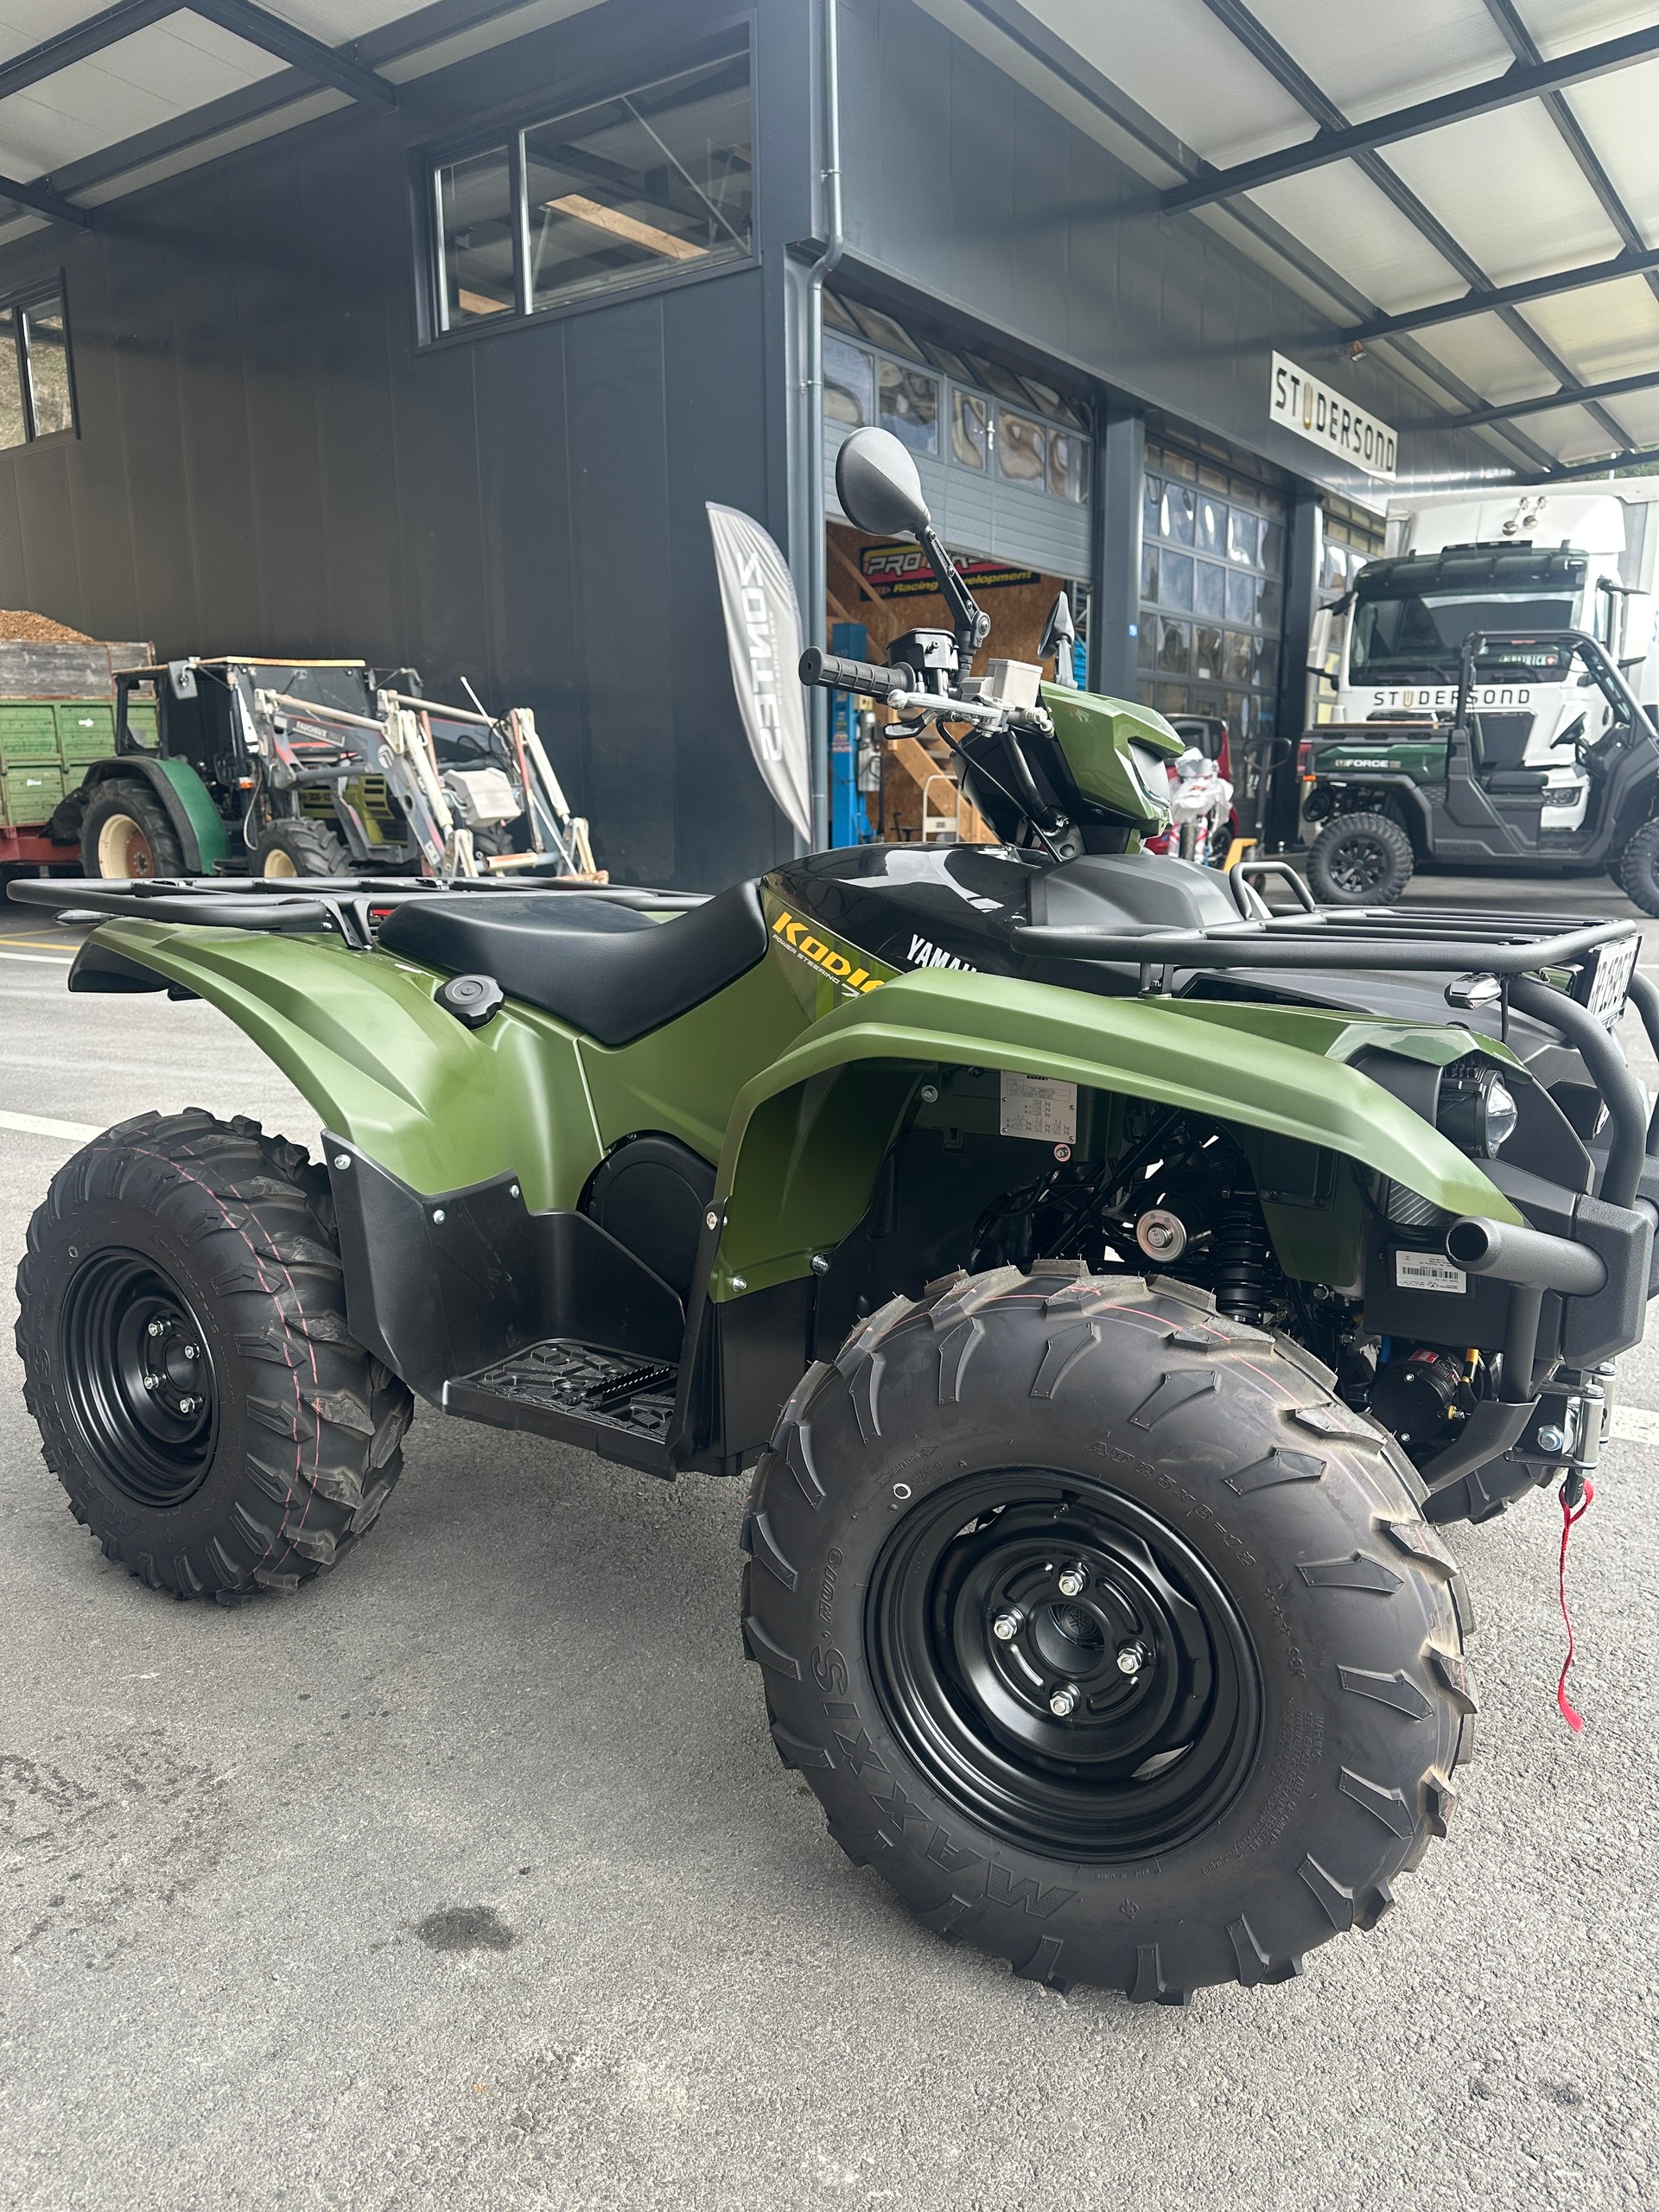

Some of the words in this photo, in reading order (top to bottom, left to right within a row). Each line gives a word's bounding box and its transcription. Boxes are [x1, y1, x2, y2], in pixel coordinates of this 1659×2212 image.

[1274, 366, 1395, 472] STUDERSOND
[893, 581, 938, 593] Racing
[772, 933, 797, 955] POWER
[797, 953, 840, 985] STEERING
[887, 1448, 922, 1478] ROTATION
[810, 1644, 1078, 1920] MAXXIS
